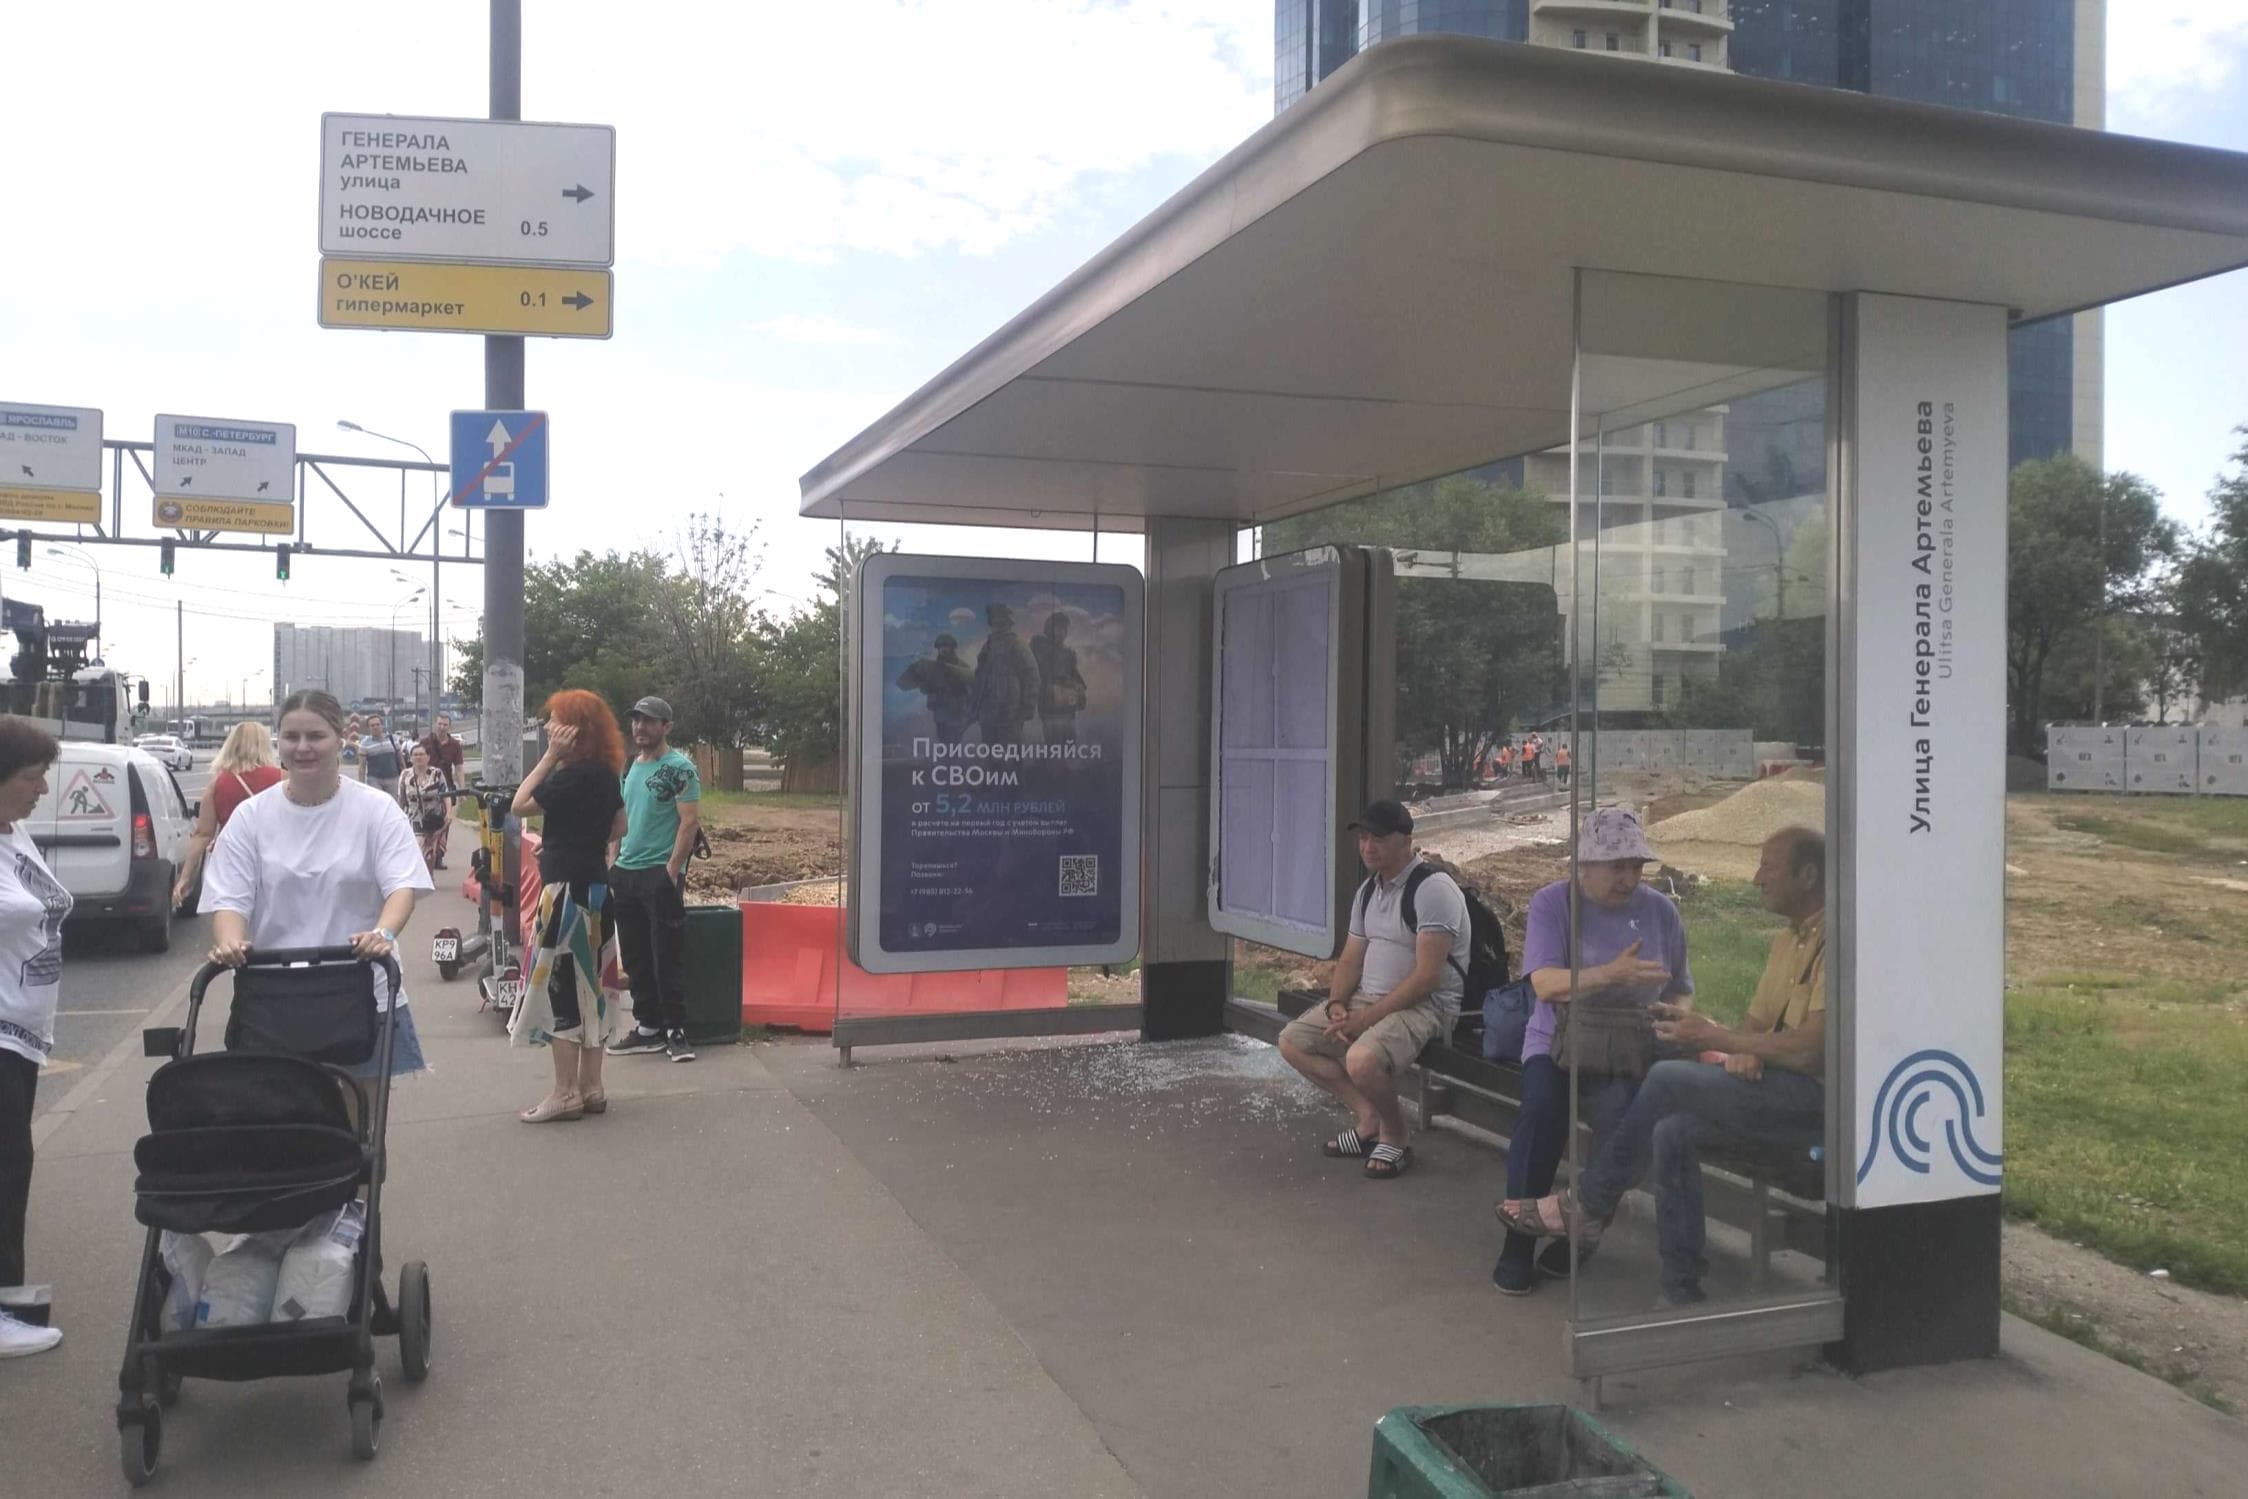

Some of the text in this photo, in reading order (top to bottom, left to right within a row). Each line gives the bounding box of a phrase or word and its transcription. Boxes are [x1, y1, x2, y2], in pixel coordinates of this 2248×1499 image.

[341, 131, 451, 151] ГЕНЕРАЛА
[340, 154, 468, 174] АРТЕМЬЕВА
[340, 175, 401, 191] улица
[339, 204, 486, 225] НОВОДАЧНОЕ
[339, 226, 402, 240] шоссе
[520, 220, 549, 237] 0.5
[336, 271, 399, 291] О'КЕЙ
[520, 291, 547, 307] 0.1
[336, 298, 464, 317] гипермаркет
[8, 415, 76, 428] ЯРОСЛАВЛЬ
[24, 433, 67, 444] ВОСТОК
[173, 444, 203, 455] МКАД
[211, 446, 247, 457] ЗАПАД
[172, 457, 207, 466] ЦЕНТР
[185, 504, 256, 516] СОБЛЮДАЙТЕ
[185, 515, 232, 526] ПРАВИЛА
[1939, 402, 1957, 680] Ulitsa Generala Artemyeva
[1910, 401, 1937, 834] Улица Генерала Артемьева
[912, 737, 1102, 762] Присоединяйся
[911, 766, 1019, 786] к СВОим
[911, 793, 1066, 818] от 5,2 МЛН РУБЛЕЙ
[435, 940, 456, 950] КР9
[434, 951, 453, 960] 96А
[499, 983, 517, 994] КН
[501, 994, 517, 1006] 42
